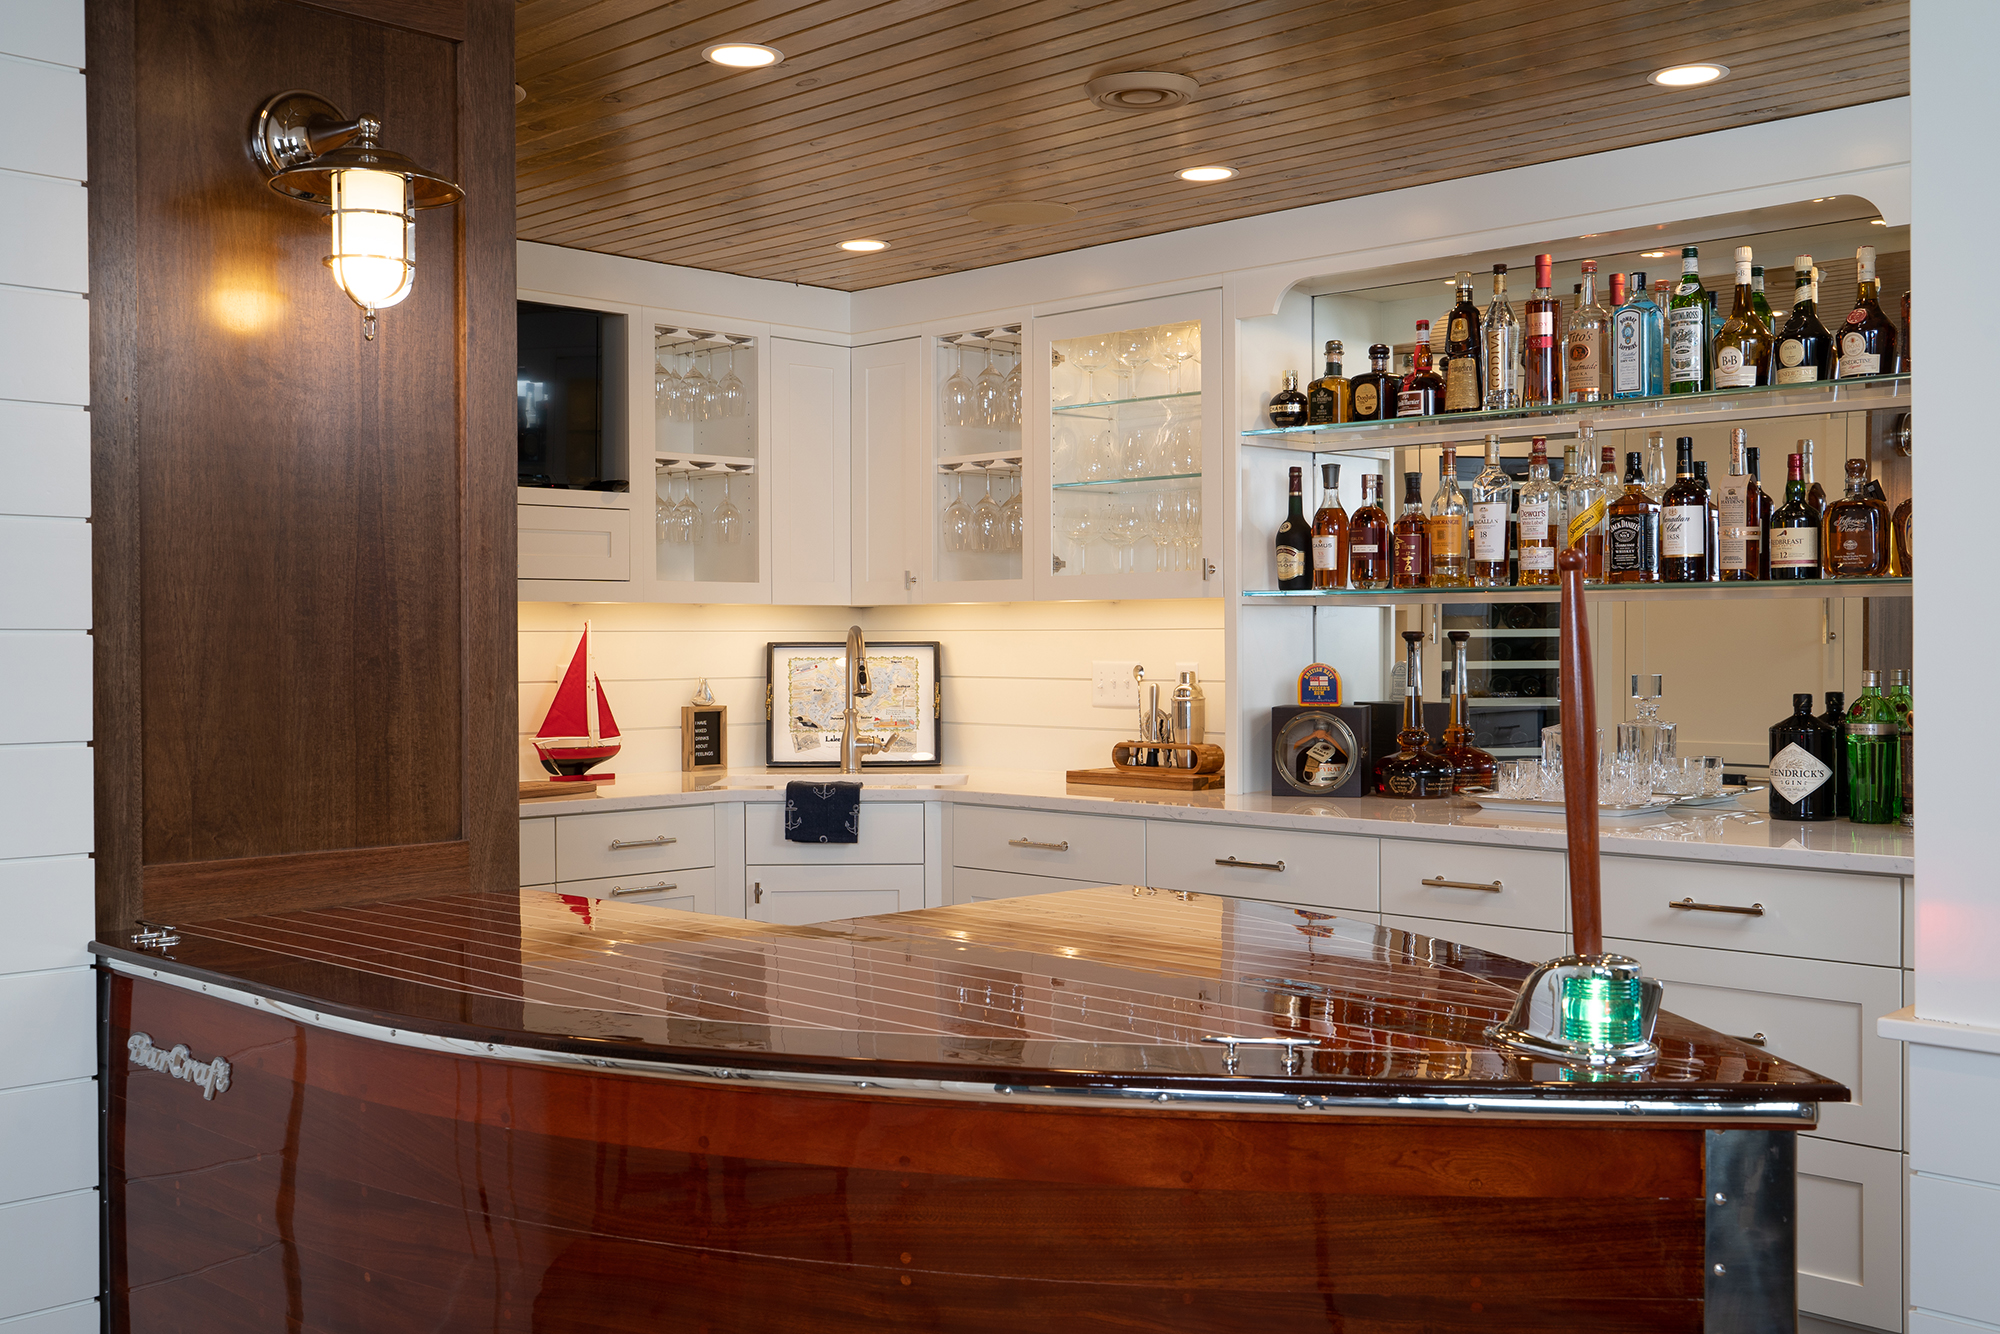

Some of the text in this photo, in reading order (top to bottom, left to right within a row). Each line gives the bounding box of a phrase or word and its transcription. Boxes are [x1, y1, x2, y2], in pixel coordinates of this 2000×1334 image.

[1619, 316, 1638, 325] BOMBAY
[1618, 341, 1638, 351] SAPPHIRE
[1491, 333, 1500, 389] GODIVA
[1521, 509, 1547, 518] Dewar's
[1480, 531, 1488, 539] 18
[1303, 667, 1323, 680] BRITISH
[825, 735, 841, 743] Lake
[1770, 769, 1825, 778] HENDRICK'S
[127, 1031, 232, 1101] BarCraft
